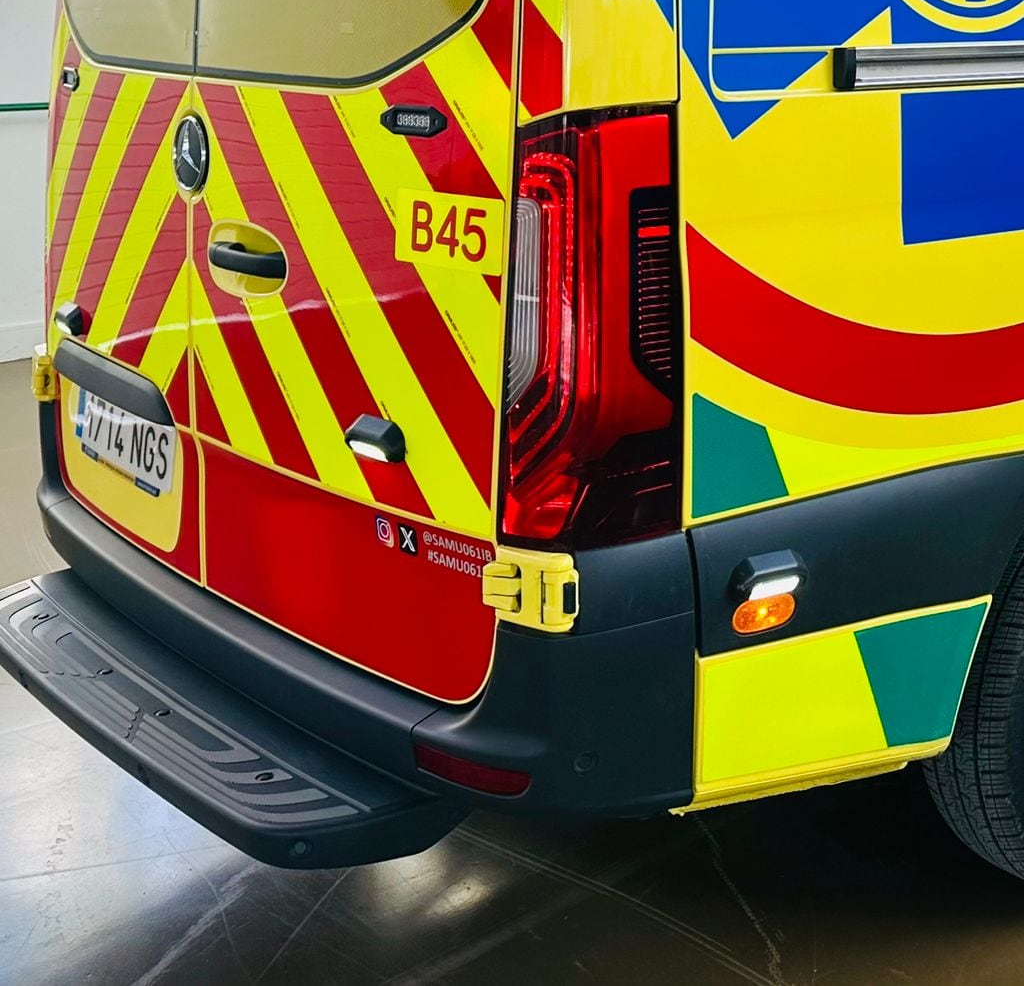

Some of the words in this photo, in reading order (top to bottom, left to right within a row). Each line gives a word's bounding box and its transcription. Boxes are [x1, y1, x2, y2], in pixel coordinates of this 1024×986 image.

[411, 200, 487, 263] B45
[130, 422, 169, 480] NGS
[422, 530, 493, 562] @SAMU061IB
